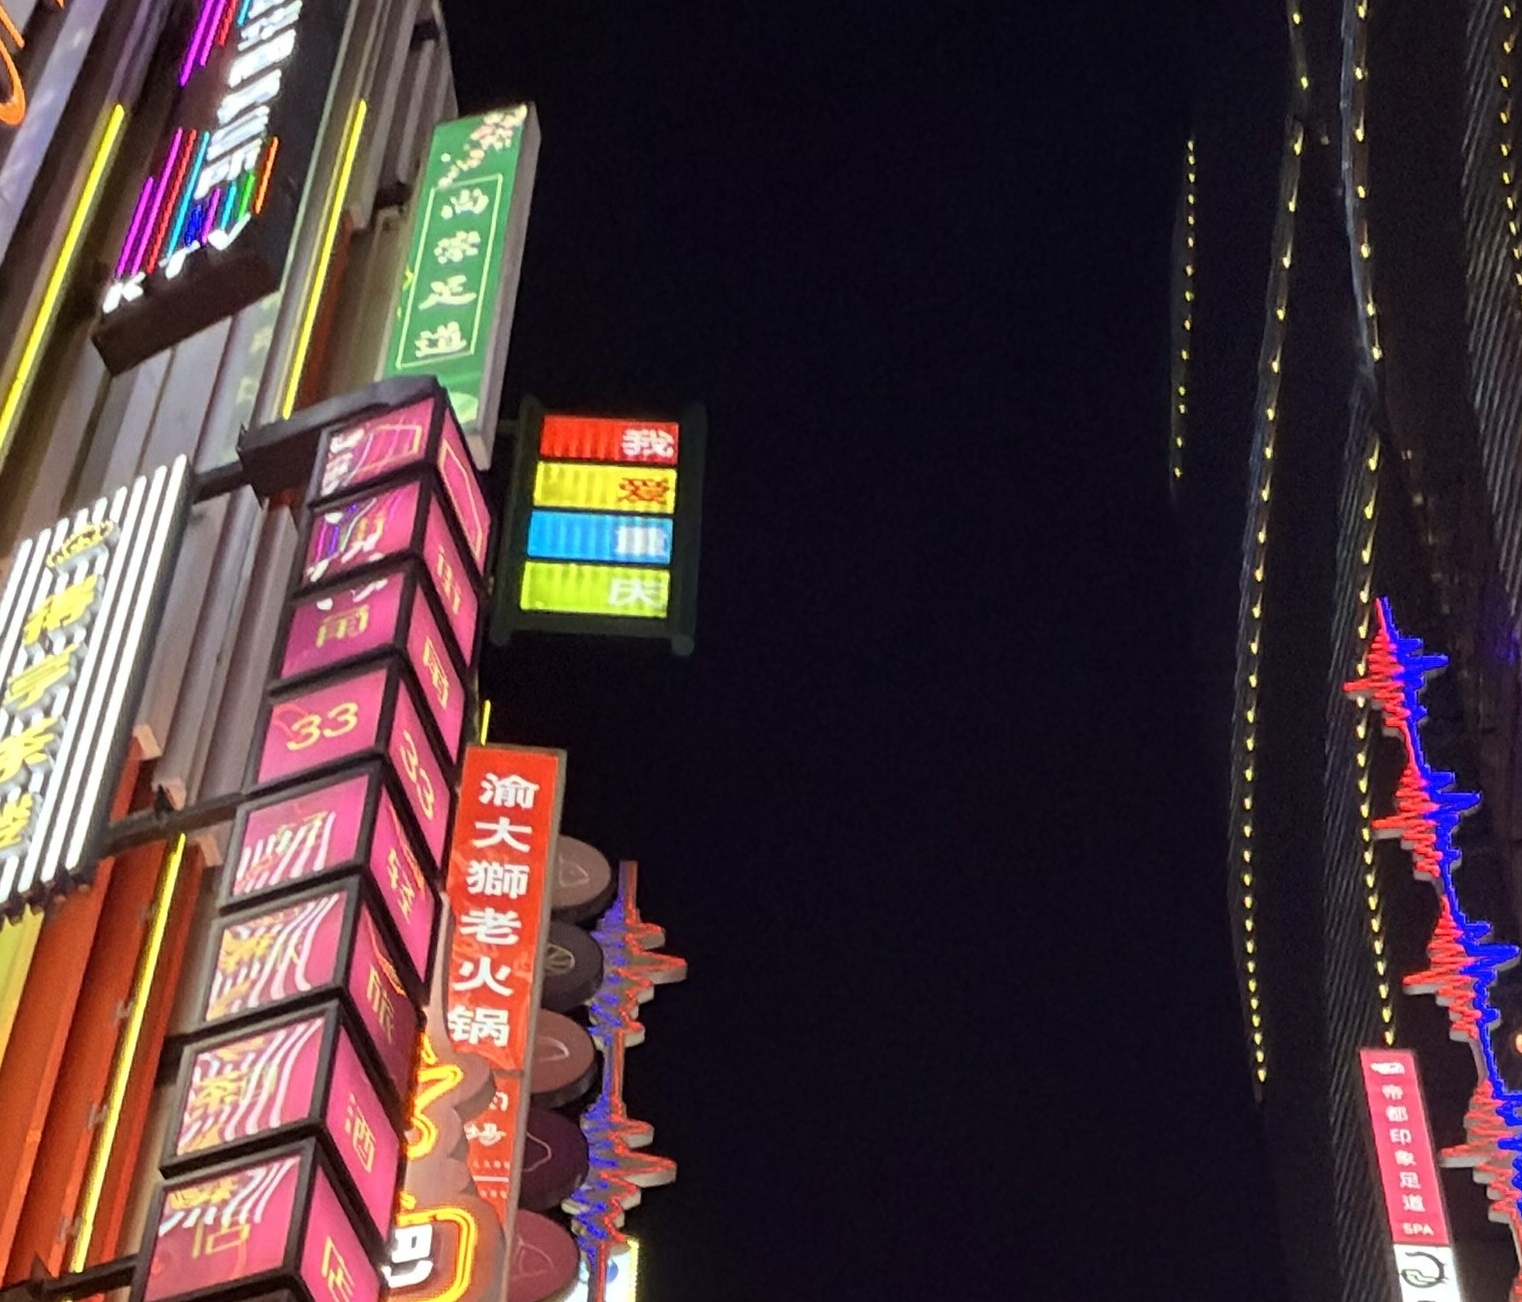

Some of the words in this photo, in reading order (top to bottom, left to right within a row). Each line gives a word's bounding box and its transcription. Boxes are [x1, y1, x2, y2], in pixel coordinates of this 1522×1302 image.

[103, 213, 250, 313] KTV
[607, 428, 675, 608] 我爱重庆
[1402, 1223, 1435, 1237] SPA
